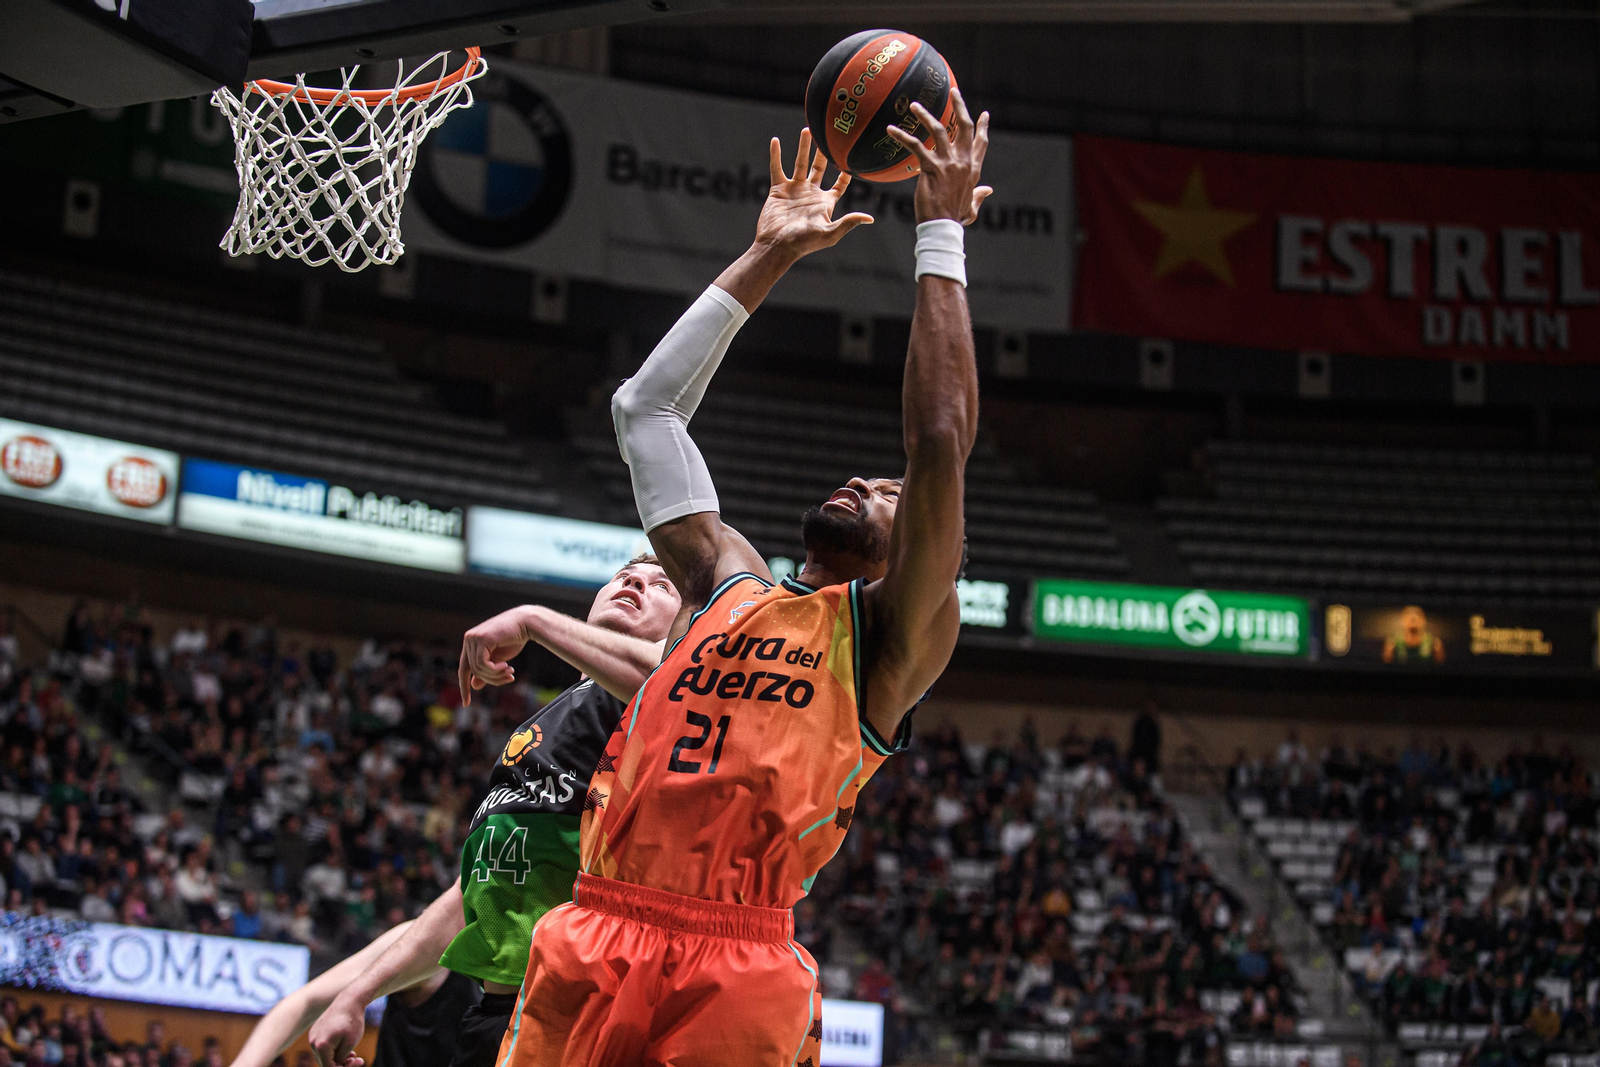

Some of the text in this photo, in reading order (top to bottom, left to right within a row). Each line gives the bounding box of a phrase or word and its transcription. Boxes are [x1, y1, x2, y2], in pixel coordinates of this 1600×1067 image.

[834, 39, 907, 134] liga endesa
[1422, 305, 1569, 350] DAMM
[784, 646, 823, 670] del
[667, 709, 731, 774] 21
[471, 825, 531, 885] 44
